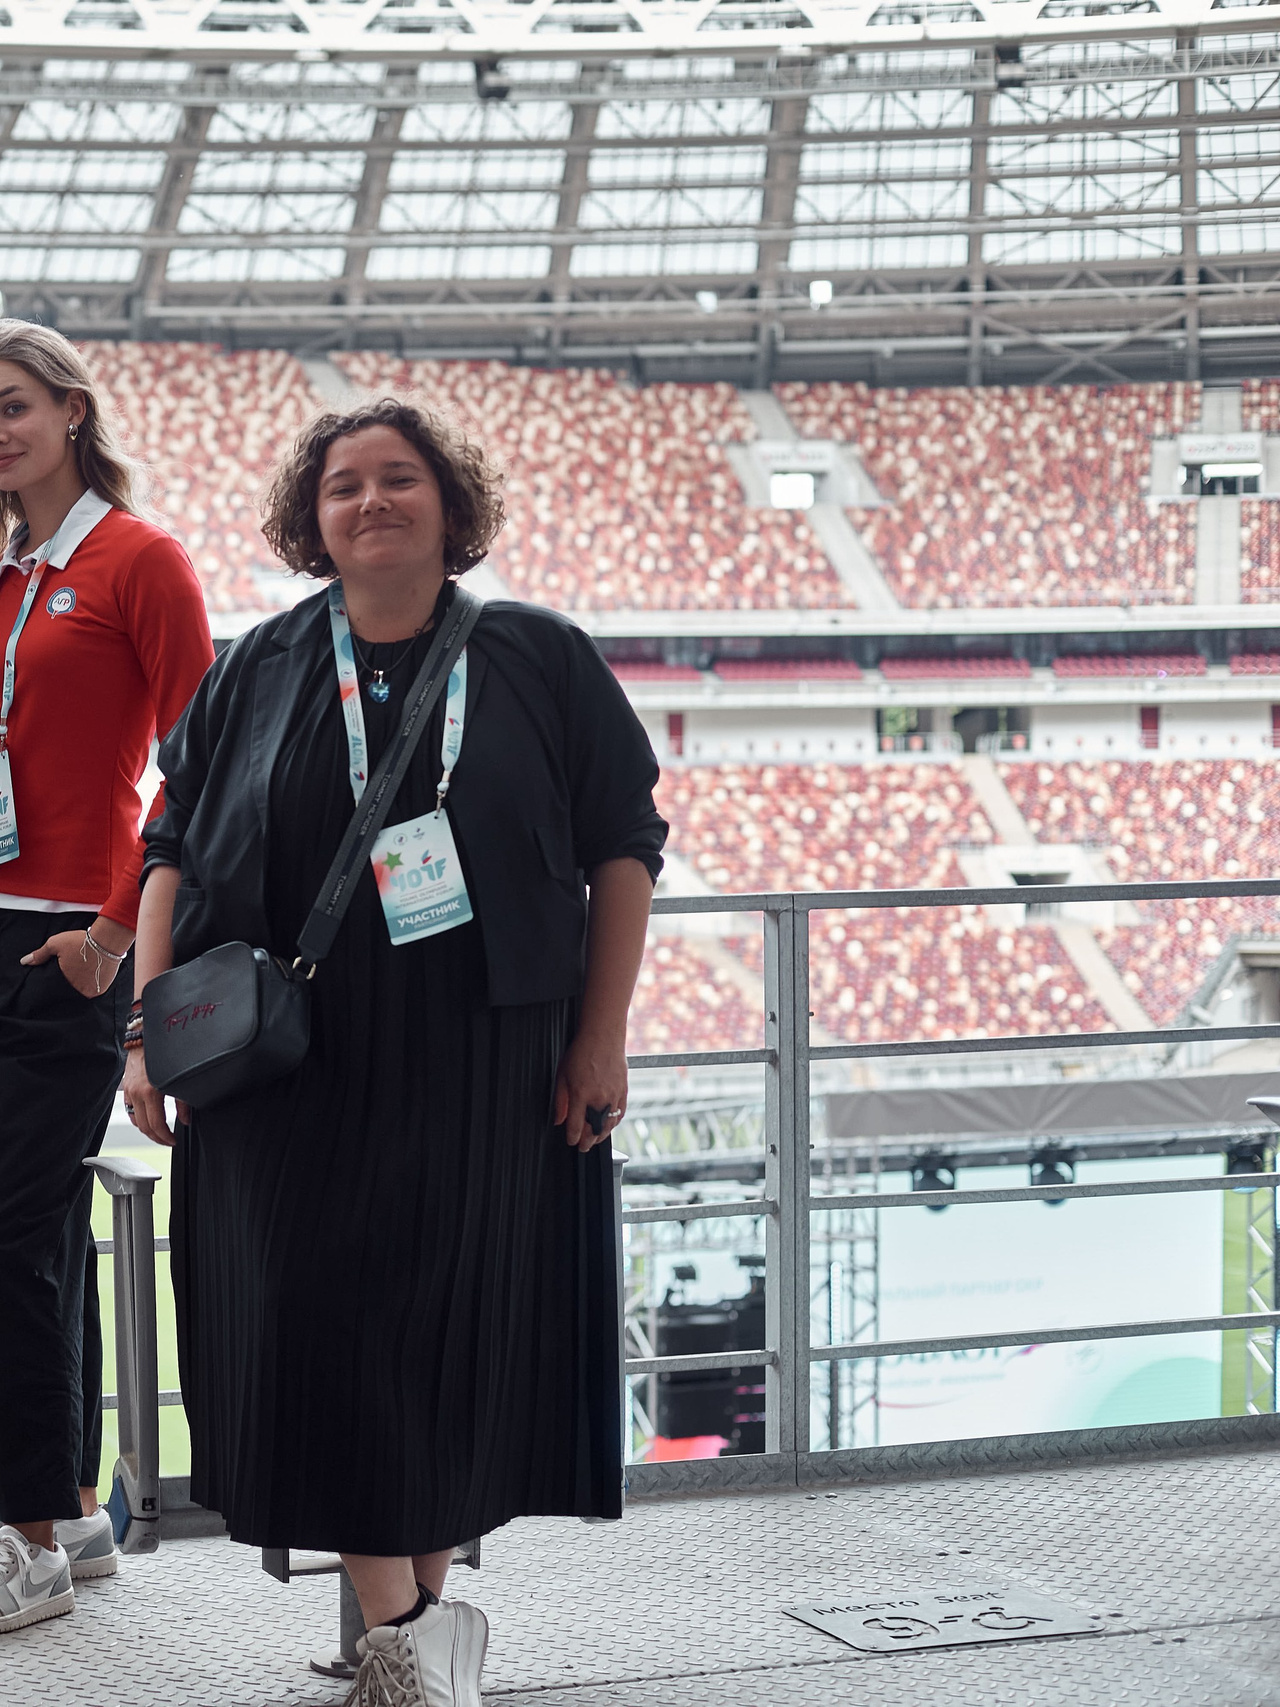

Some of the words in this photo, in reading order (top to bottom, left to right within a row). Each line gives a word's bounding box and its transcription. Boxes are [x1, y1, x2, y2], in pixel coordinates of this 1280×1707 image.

[419, 680, 433, 705] TOMMY
[402, 706, 420, 736] HILFIGER
[374, 774, 392, 802] TOMMY
[359, 804, 377, 836] HILFIGER
[330, 875, 347, 905] TOMMY
[397, 899, 461, 928] УЧАСТНИК
[813, 1600, 920, 1615] Место
[934, 1592, 1006, 1604] Seat
